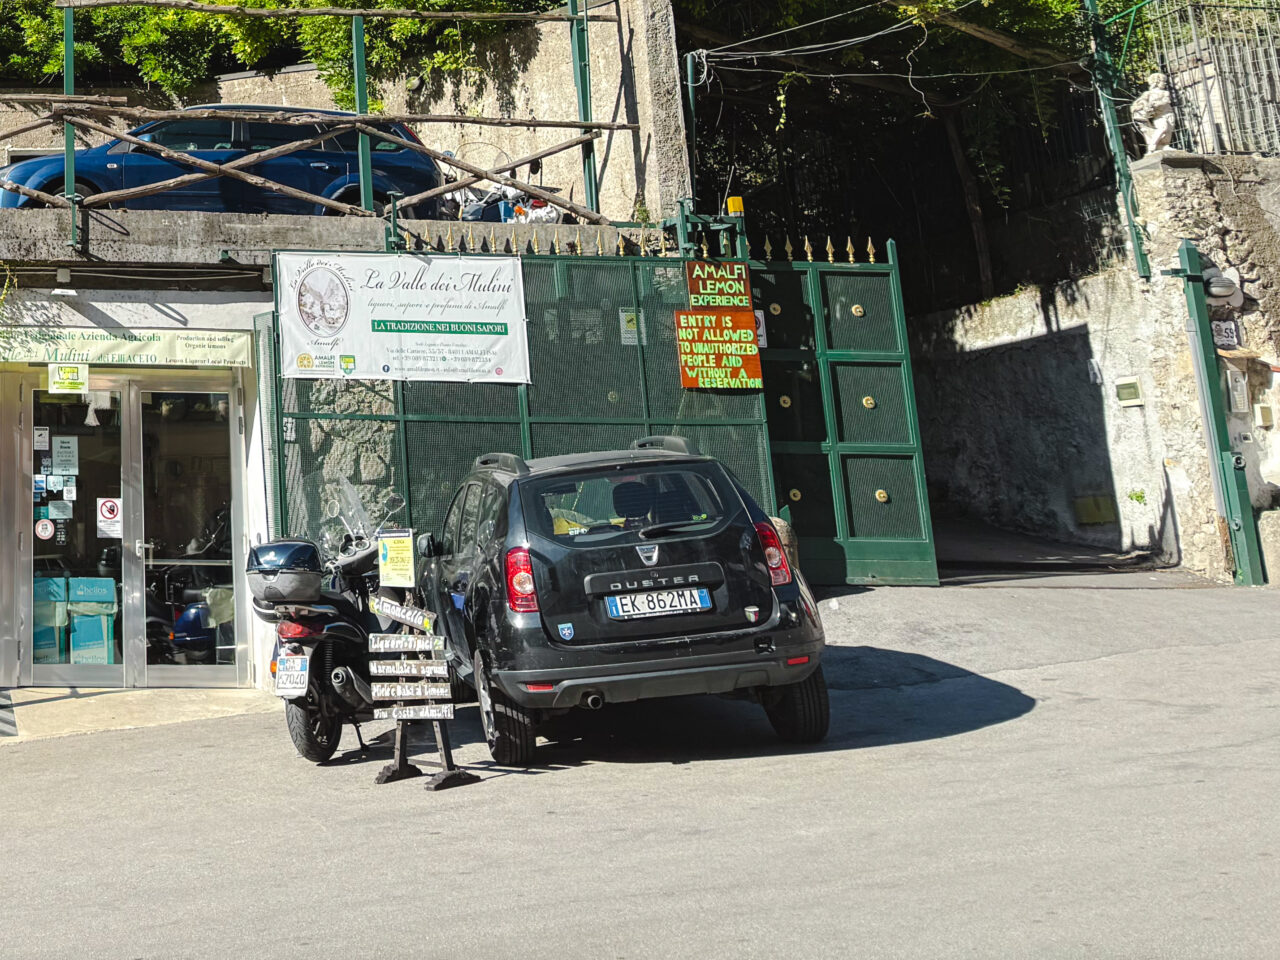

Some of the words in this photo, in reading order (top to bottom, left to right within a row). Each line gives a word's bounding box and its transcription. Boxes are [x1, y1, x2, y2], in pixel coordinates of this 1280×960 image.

[692, 264, 746, 279] AMALFI
[360, 268, 384, 289] La
[388, 265, 427, 290] Valle
[430, 272, 453, 291] dei
[453, 266, 514, 293] Mulini
[699, 280, 745, 294] LEMON
[690, 294, 750, 306] EXPERIENCE
[396, 301, 423, 315] sapori
[429, 297, 463, 316] profumi
[464, 301, 472, 310] di
[473, 299, 509, 317] Amalfi
[374, 322, 385, 330] LA
[386, 322, 434, 332] TRADIZIONE
[436, 324, 450, 332] NEI
[451, 324, 477, 332] BUONI
[477, 324, 505, 333] SAPORI
[680, 315, 717, 327] ENTRY
[722, 315, 732, 328] IS
[76, 332, 117, 342] Azienda
[120, 333, 161, 343] Agricola
[678, 328, 699, 340] NOT
[703, 329, 754, 341] ALLOWED
[1224, 328, 1234, 338] 59
[41, 346, 90, 362] Mulini
[126, 354, 157, 363] ACETO
[679, 341, 691, 353] TO
[692, 342, 758, 355] UNAUTHORIZED
[681, 354, 716, 367] PEOPLE
[721, 355, 743, 367] AND
[685, 367, 732, 378] WITHOUT
[738, 368, 748, 379] A
[698, 378, 763, 388] RESERVATION
[610, 575, 699, 590] DUSTER
[620, 594, 640, 613] EK
[646, 590, 699, 611] 862MA
